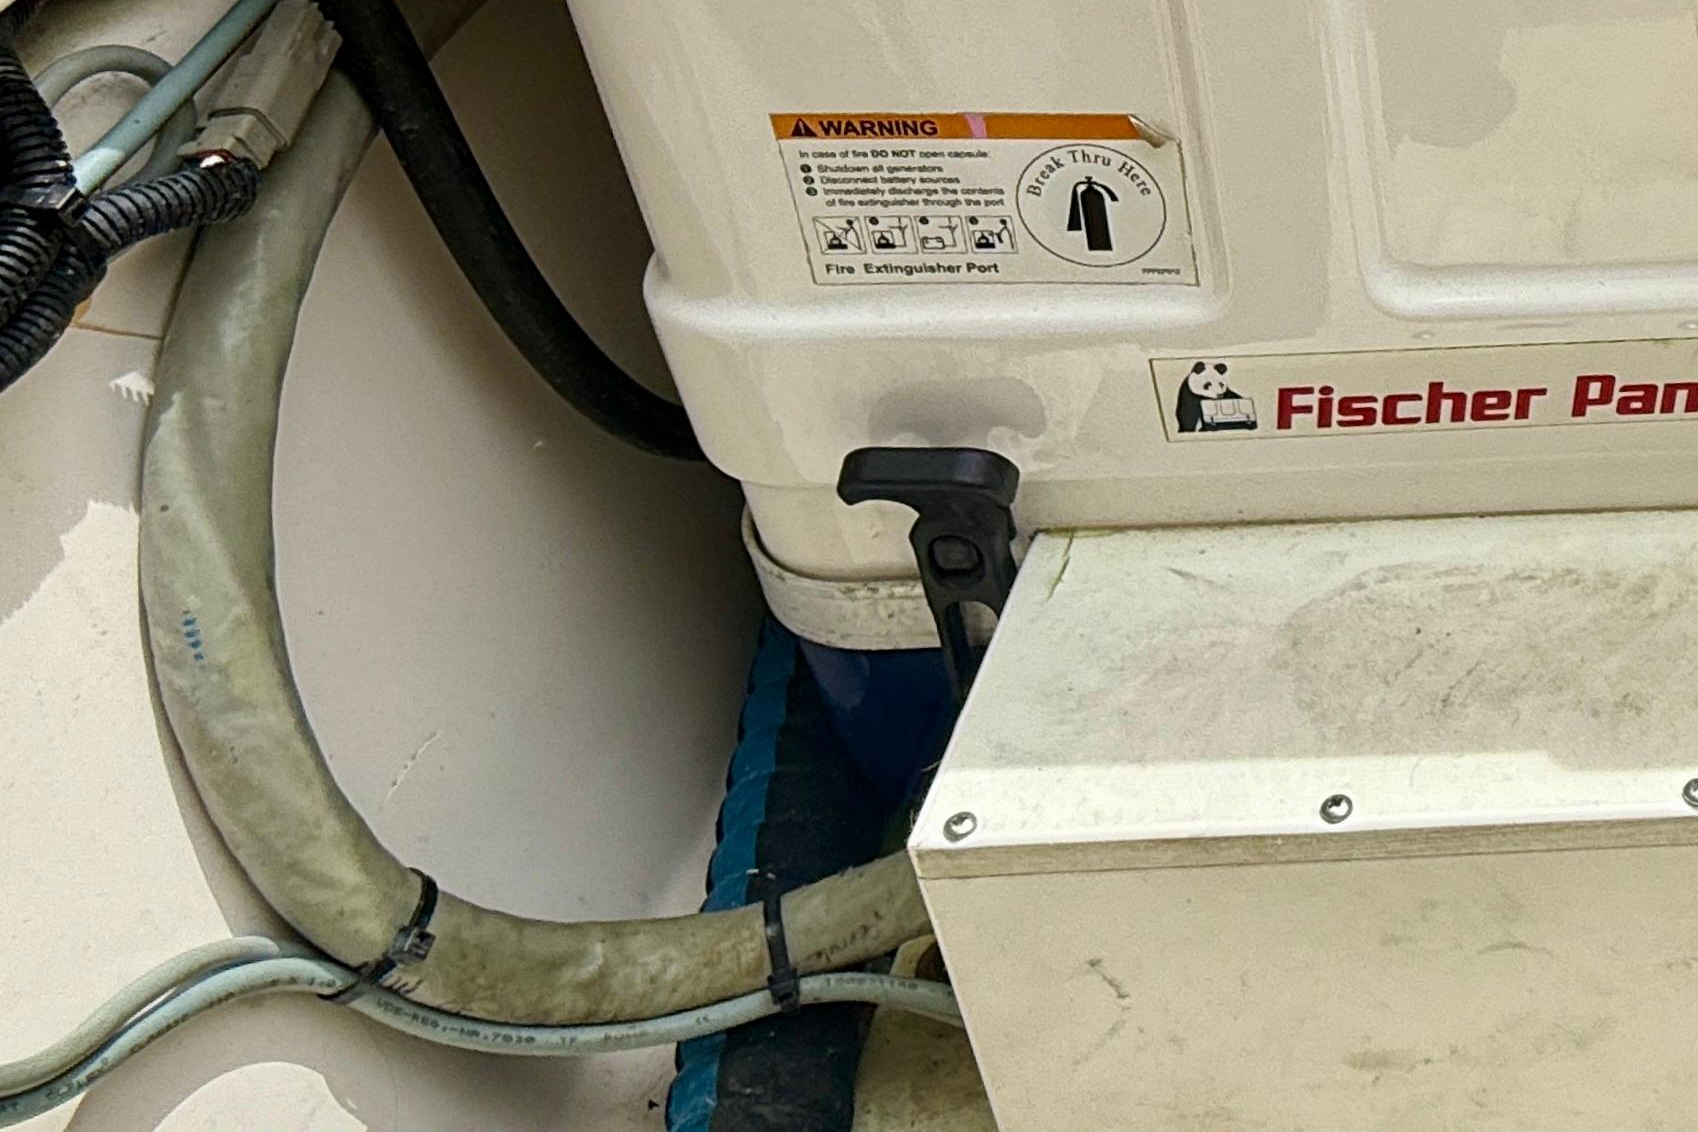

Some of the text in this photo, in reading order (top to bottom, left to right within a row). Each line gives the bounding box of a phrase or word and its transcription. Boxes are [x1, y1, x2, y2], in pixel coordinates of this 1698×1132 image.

[818, 120, 939, 137] WARNING
[799, 149, 991, 160] In case of fire DO NOT open capsule:
[817, 165, 870, 173] Shutdown
[886, 165, 944, 174] generators
[1026, 150, 1152, 197] Break Thru Here
[820, 176, 878, 184] Disconnect
[880, 176, 917, 186] battery
[823, 187, 886, 197] Immediately
[888, 187, 939, 197] discharge
[941, 187, 958, 195] the
[960, 187, 1005, 195] contents
[825, 198, 1005, 208] of fire extinguisher through the port
[825, 262, 1000, 276] Fire Extinguisher Port
[1276, 381, 1548, 430] Fischer
